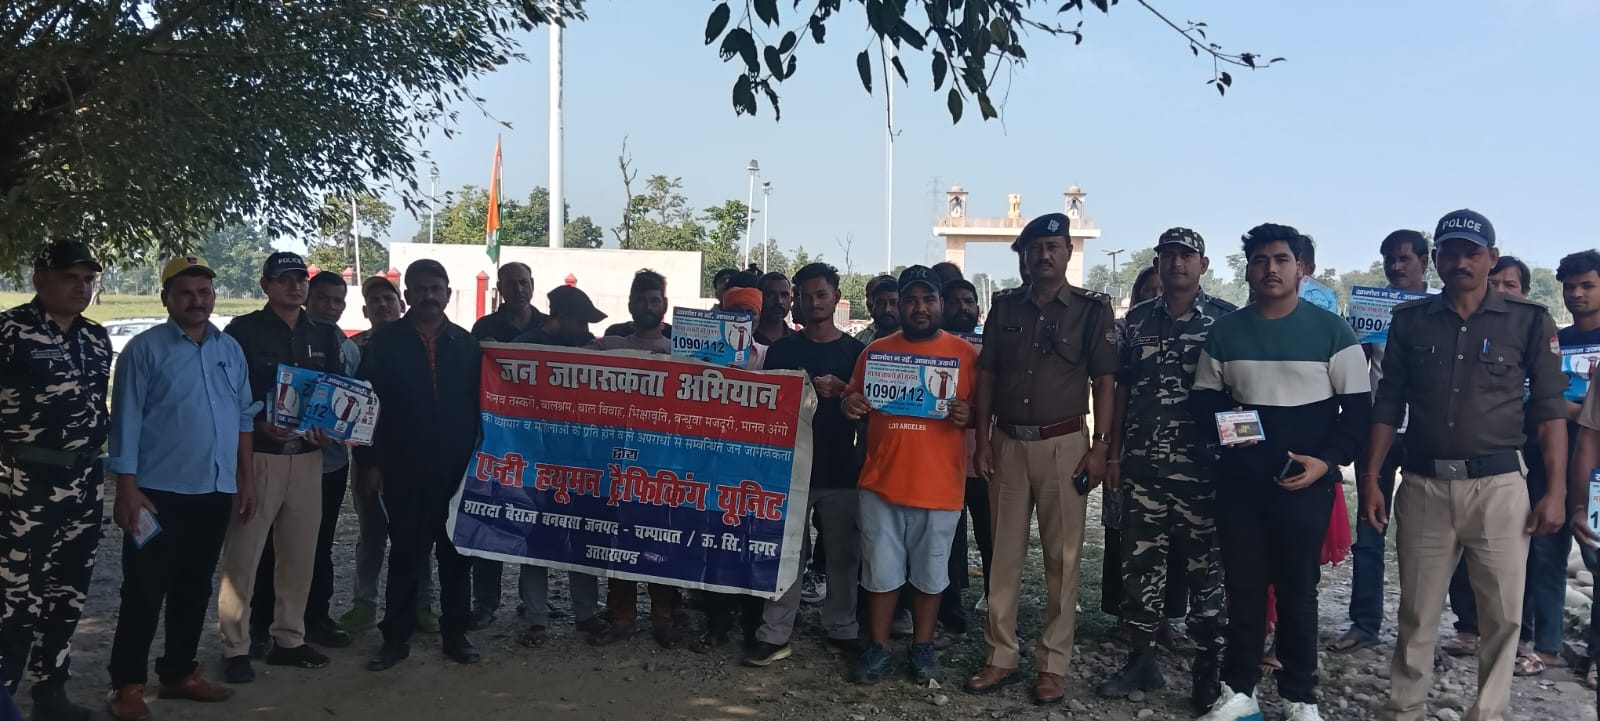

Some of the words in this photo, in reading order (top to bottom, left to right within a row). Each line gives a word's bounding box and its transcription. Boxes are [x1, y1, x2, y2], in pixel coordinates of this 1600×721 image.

[1442, 218, 1481, 232] POLICE
[672, 335, 725, 353] 1090/112
[496, 358, 539, 386] जन
[676, 368, 781, 410] अभियान
[865, 382, 925, 402] 1090/112
[577, 402, 596, 414] बाल
[741, 420, 765, 434] मानव
[900, 423, 926, 431] ANGELES
[637, 431, 672, 447] अपराधों
[726, 442, 741, 455] जन
[475, 451, 528, 488] एन्टी
[716, 480, 787, 527] यूनिट
[464, 499, 502, 519] शारदा
[505, 503, 539, 525] बैराज
[542, 512, 582, 530] बनबसा
[585, 517, 620, 536] जनपद
[634, 525, 683, 545] चम्पावत
[748, 540, 778, 557] नगर
[586, 544, 640, 565] उत्तराखण्ड
